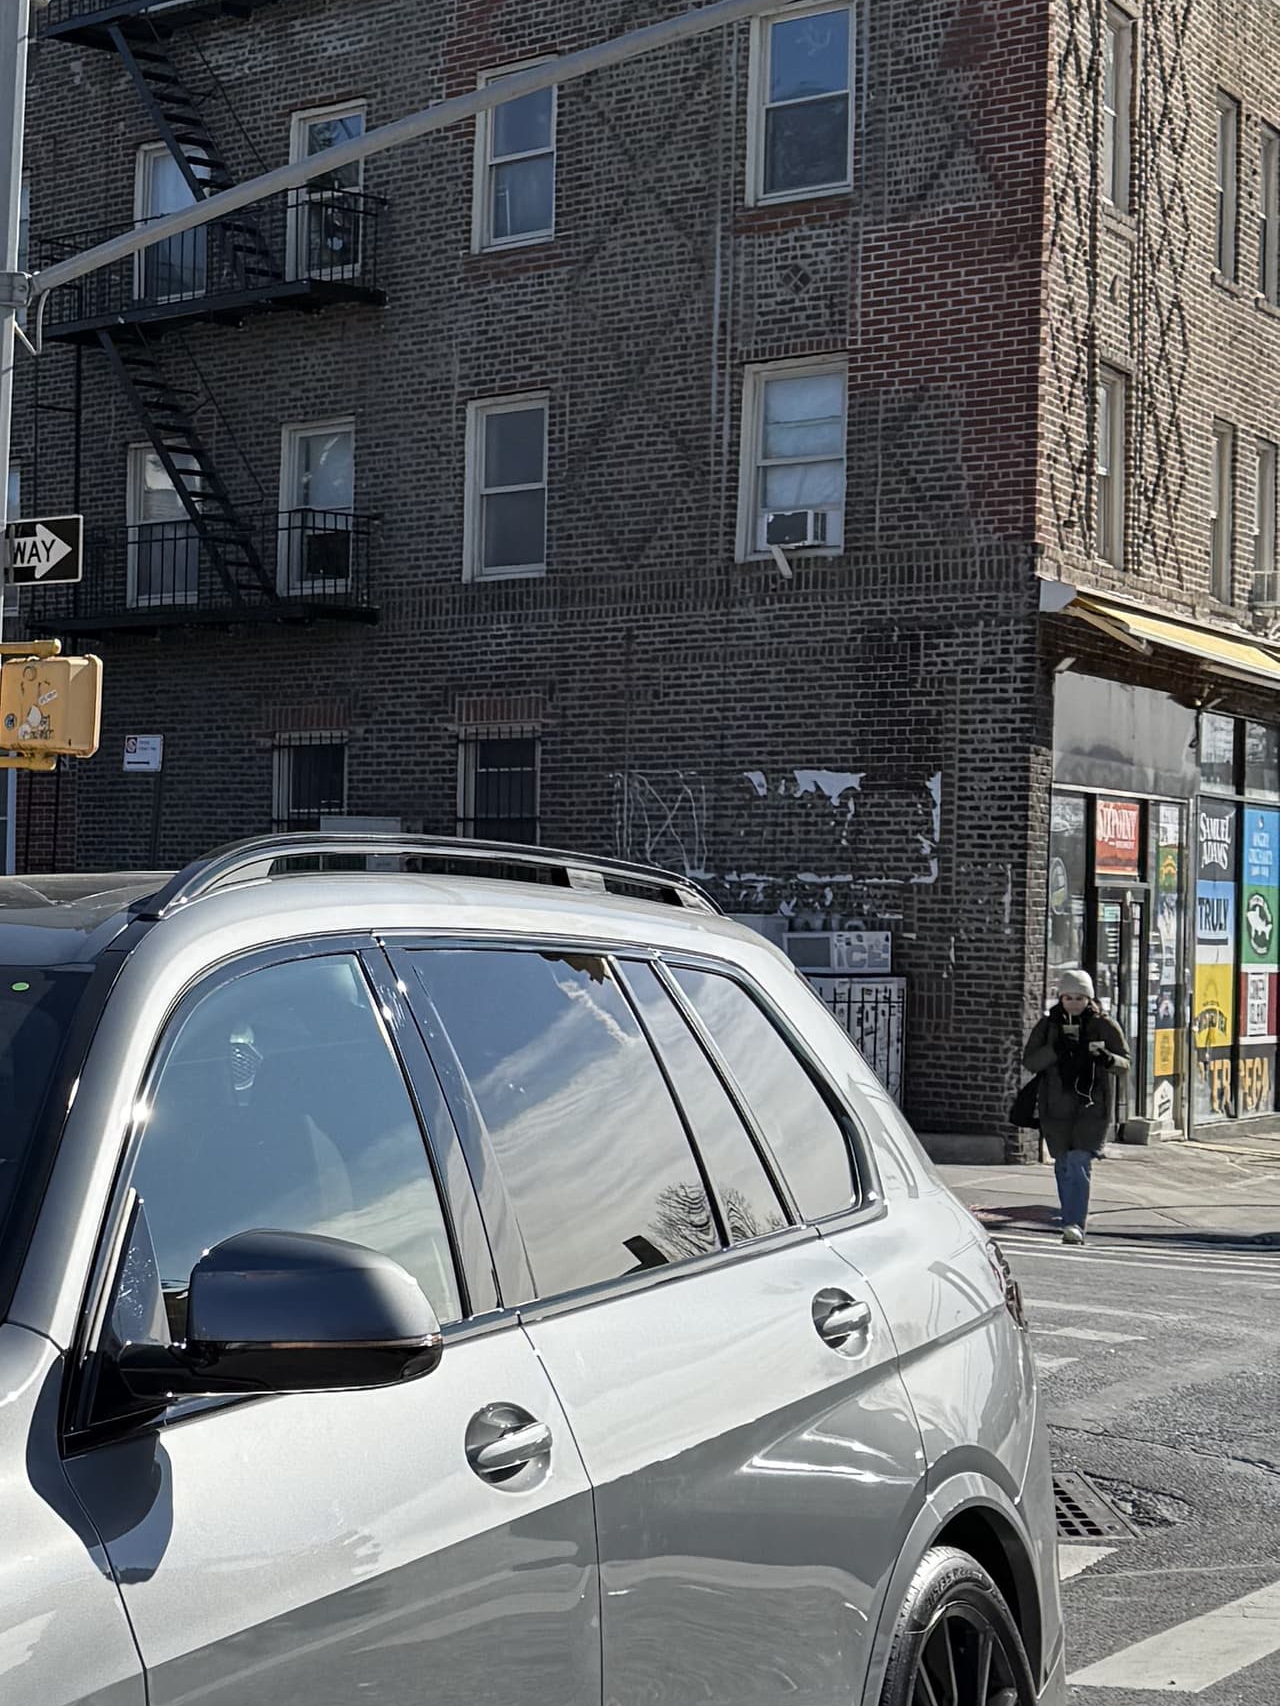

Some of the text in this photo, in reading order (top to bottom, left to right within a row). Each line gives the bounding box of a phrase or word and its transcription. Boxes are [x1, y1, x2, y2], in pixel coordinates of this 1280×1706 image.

[13, 539, 56, 564] WAY
[1199, 809, 1236, 844] SAMUEL
[1201, 841, 1229, 870] ADAMS
[1198, 897, 1229, 931] TRULY
